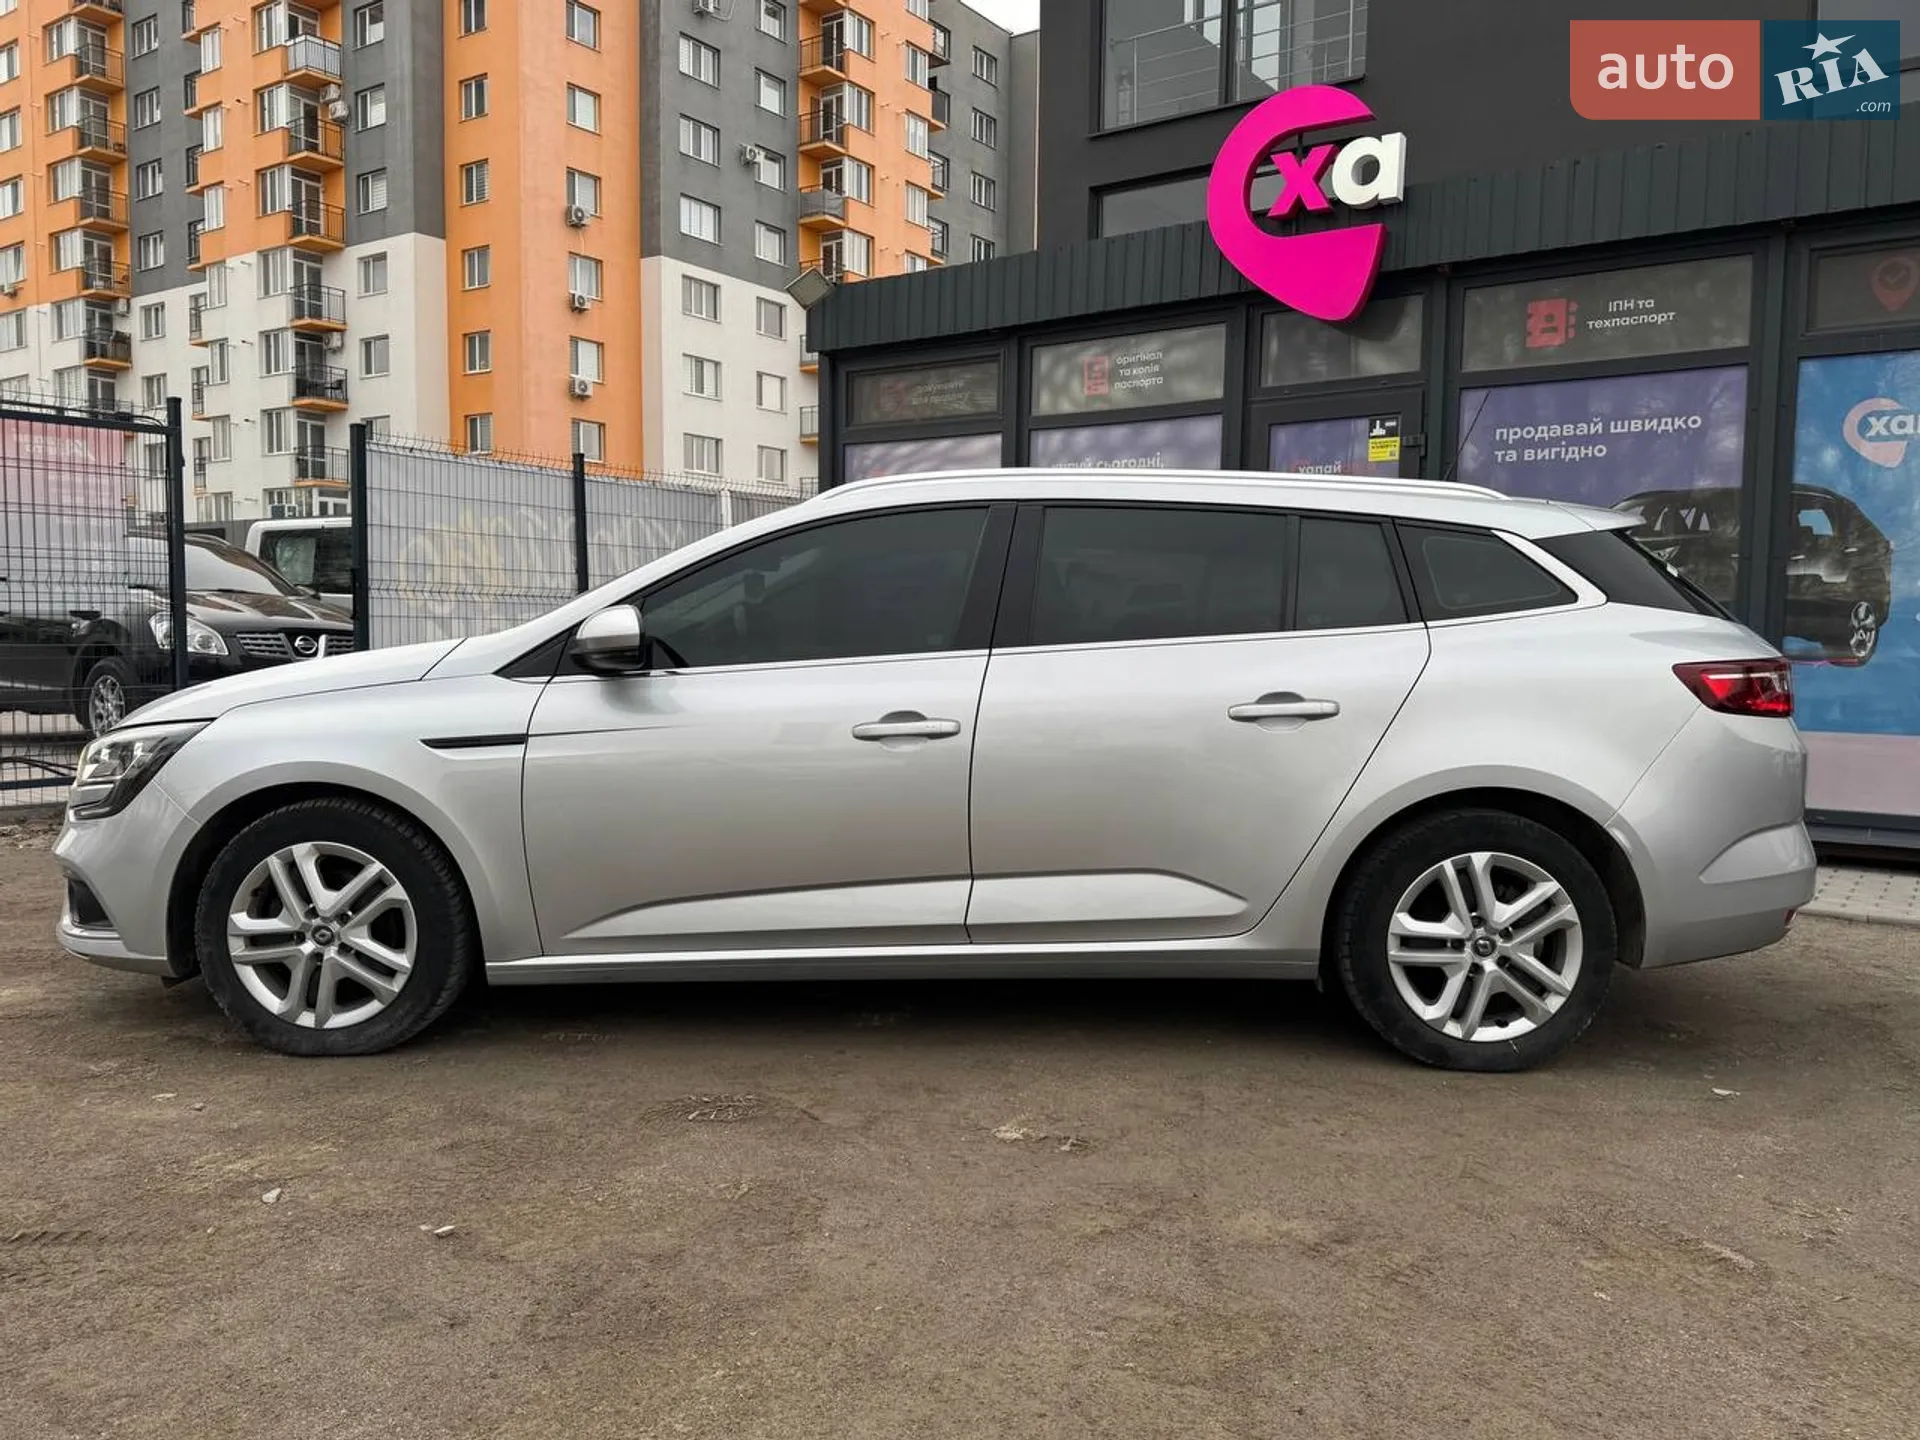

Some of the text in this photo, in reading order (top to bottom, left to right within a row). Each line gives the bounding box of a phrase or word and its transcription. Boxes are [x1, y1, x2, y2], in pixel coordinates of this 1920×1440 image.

[1637, 299, 1655, 309] та
[1586, 312, 1676, 329] техпаспорт
[1114, 376, 1164, 390] паспорта
[1495, 415, 1702, 444] продавай швидко
[1495, 440, 1607, 463] та вигідно
